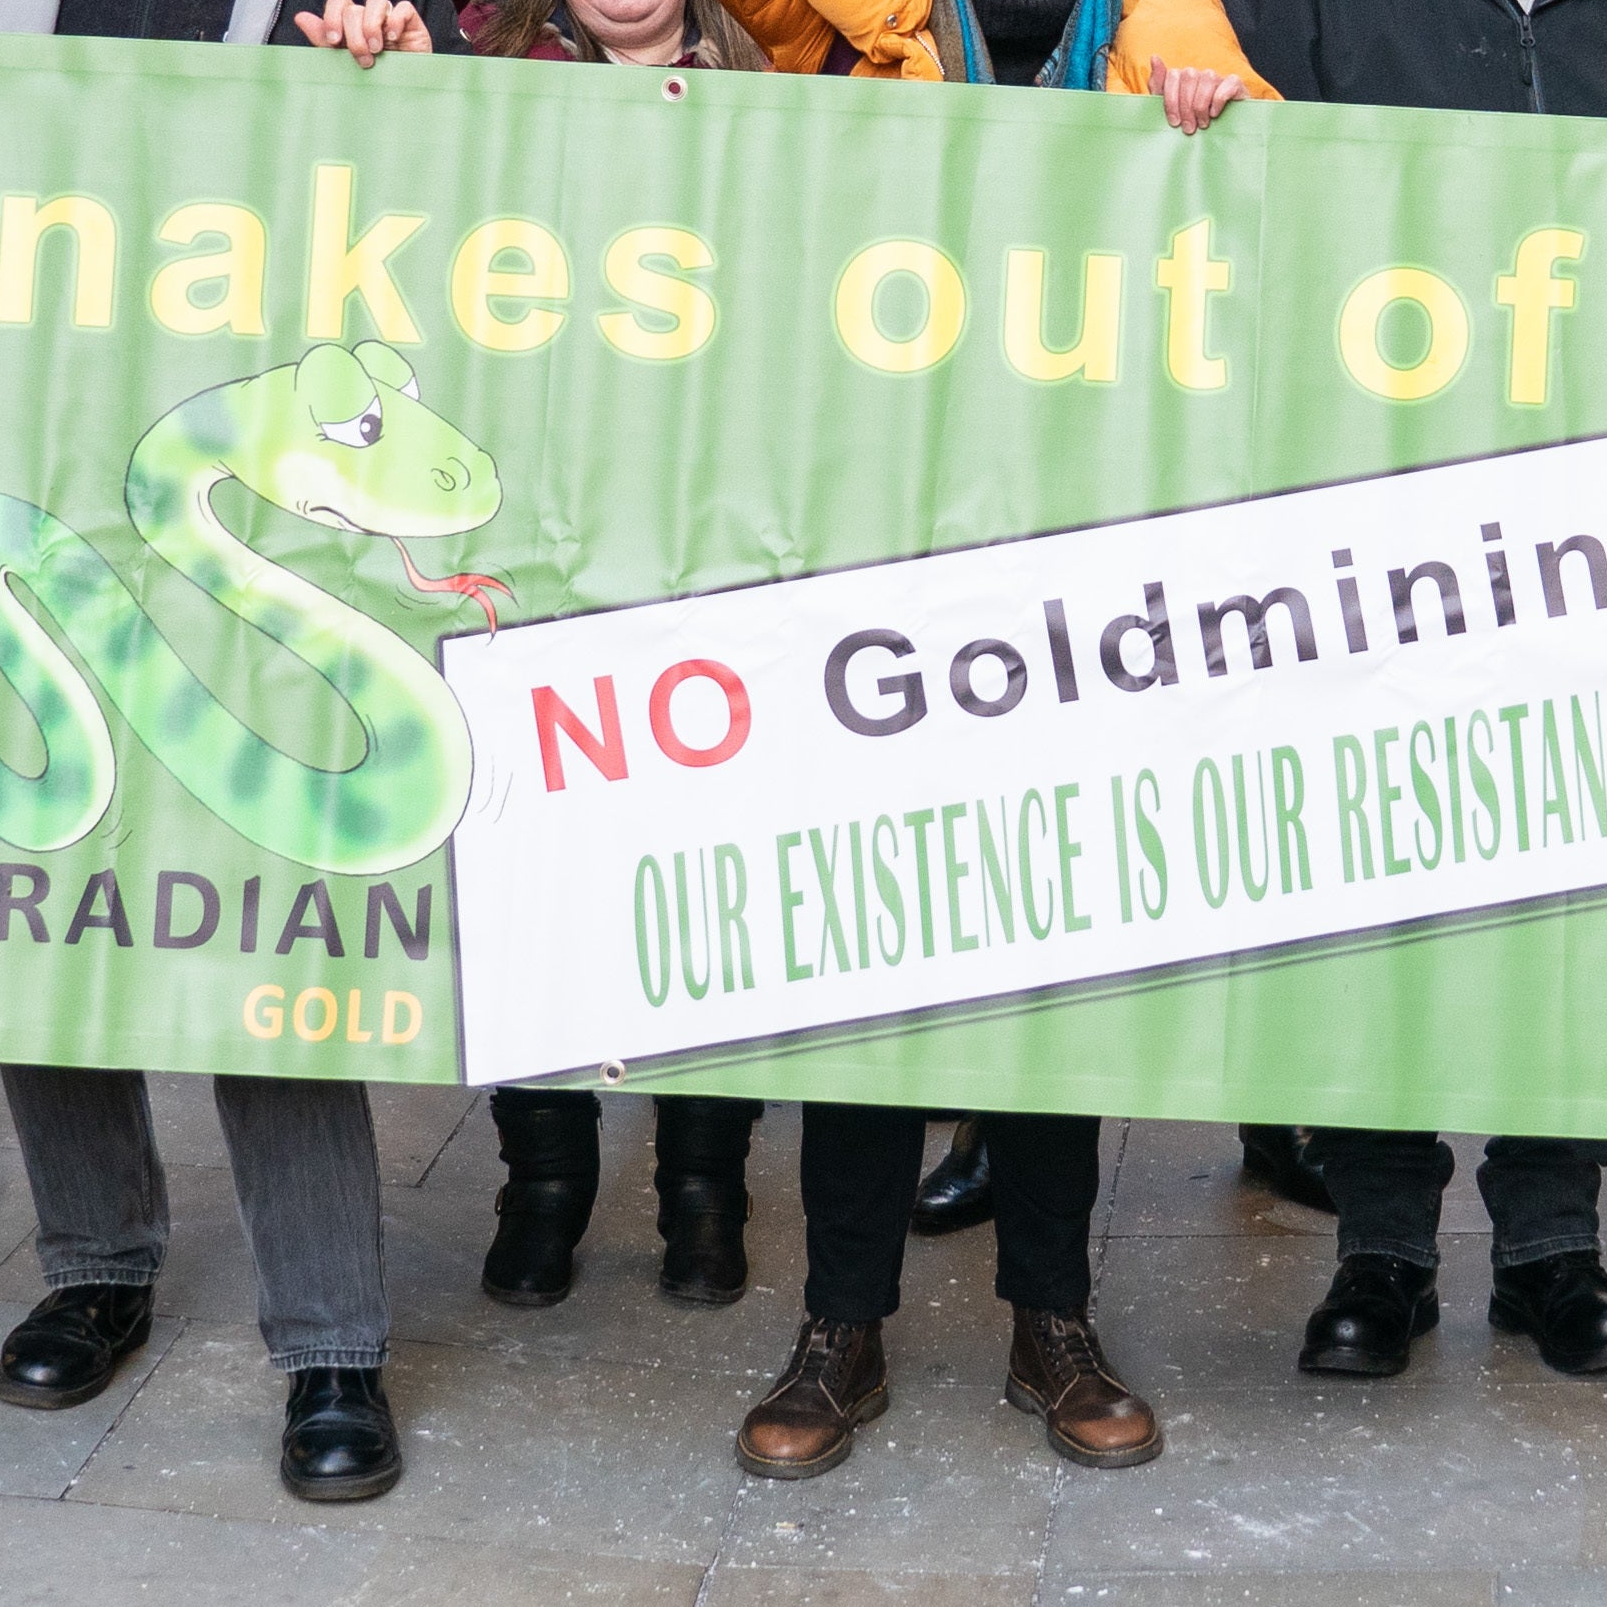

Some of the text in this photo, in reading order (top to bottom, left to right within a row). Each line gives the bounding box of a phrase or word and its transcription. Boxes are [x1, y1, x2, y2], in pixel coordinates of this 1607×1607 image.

[838, 219, 1231, 391] out
[1339, 228, 1587, 404] of
[530, 657, 752, 794] NO
[633, 840, 755, 1009] OUR
[776, 781, 1089, 983] EXISTENCE
[1112, 767, 1170, 925] IS
[1190, 745, 1314, 910] OUR
[241, 984, 424, 1046] GOLD
